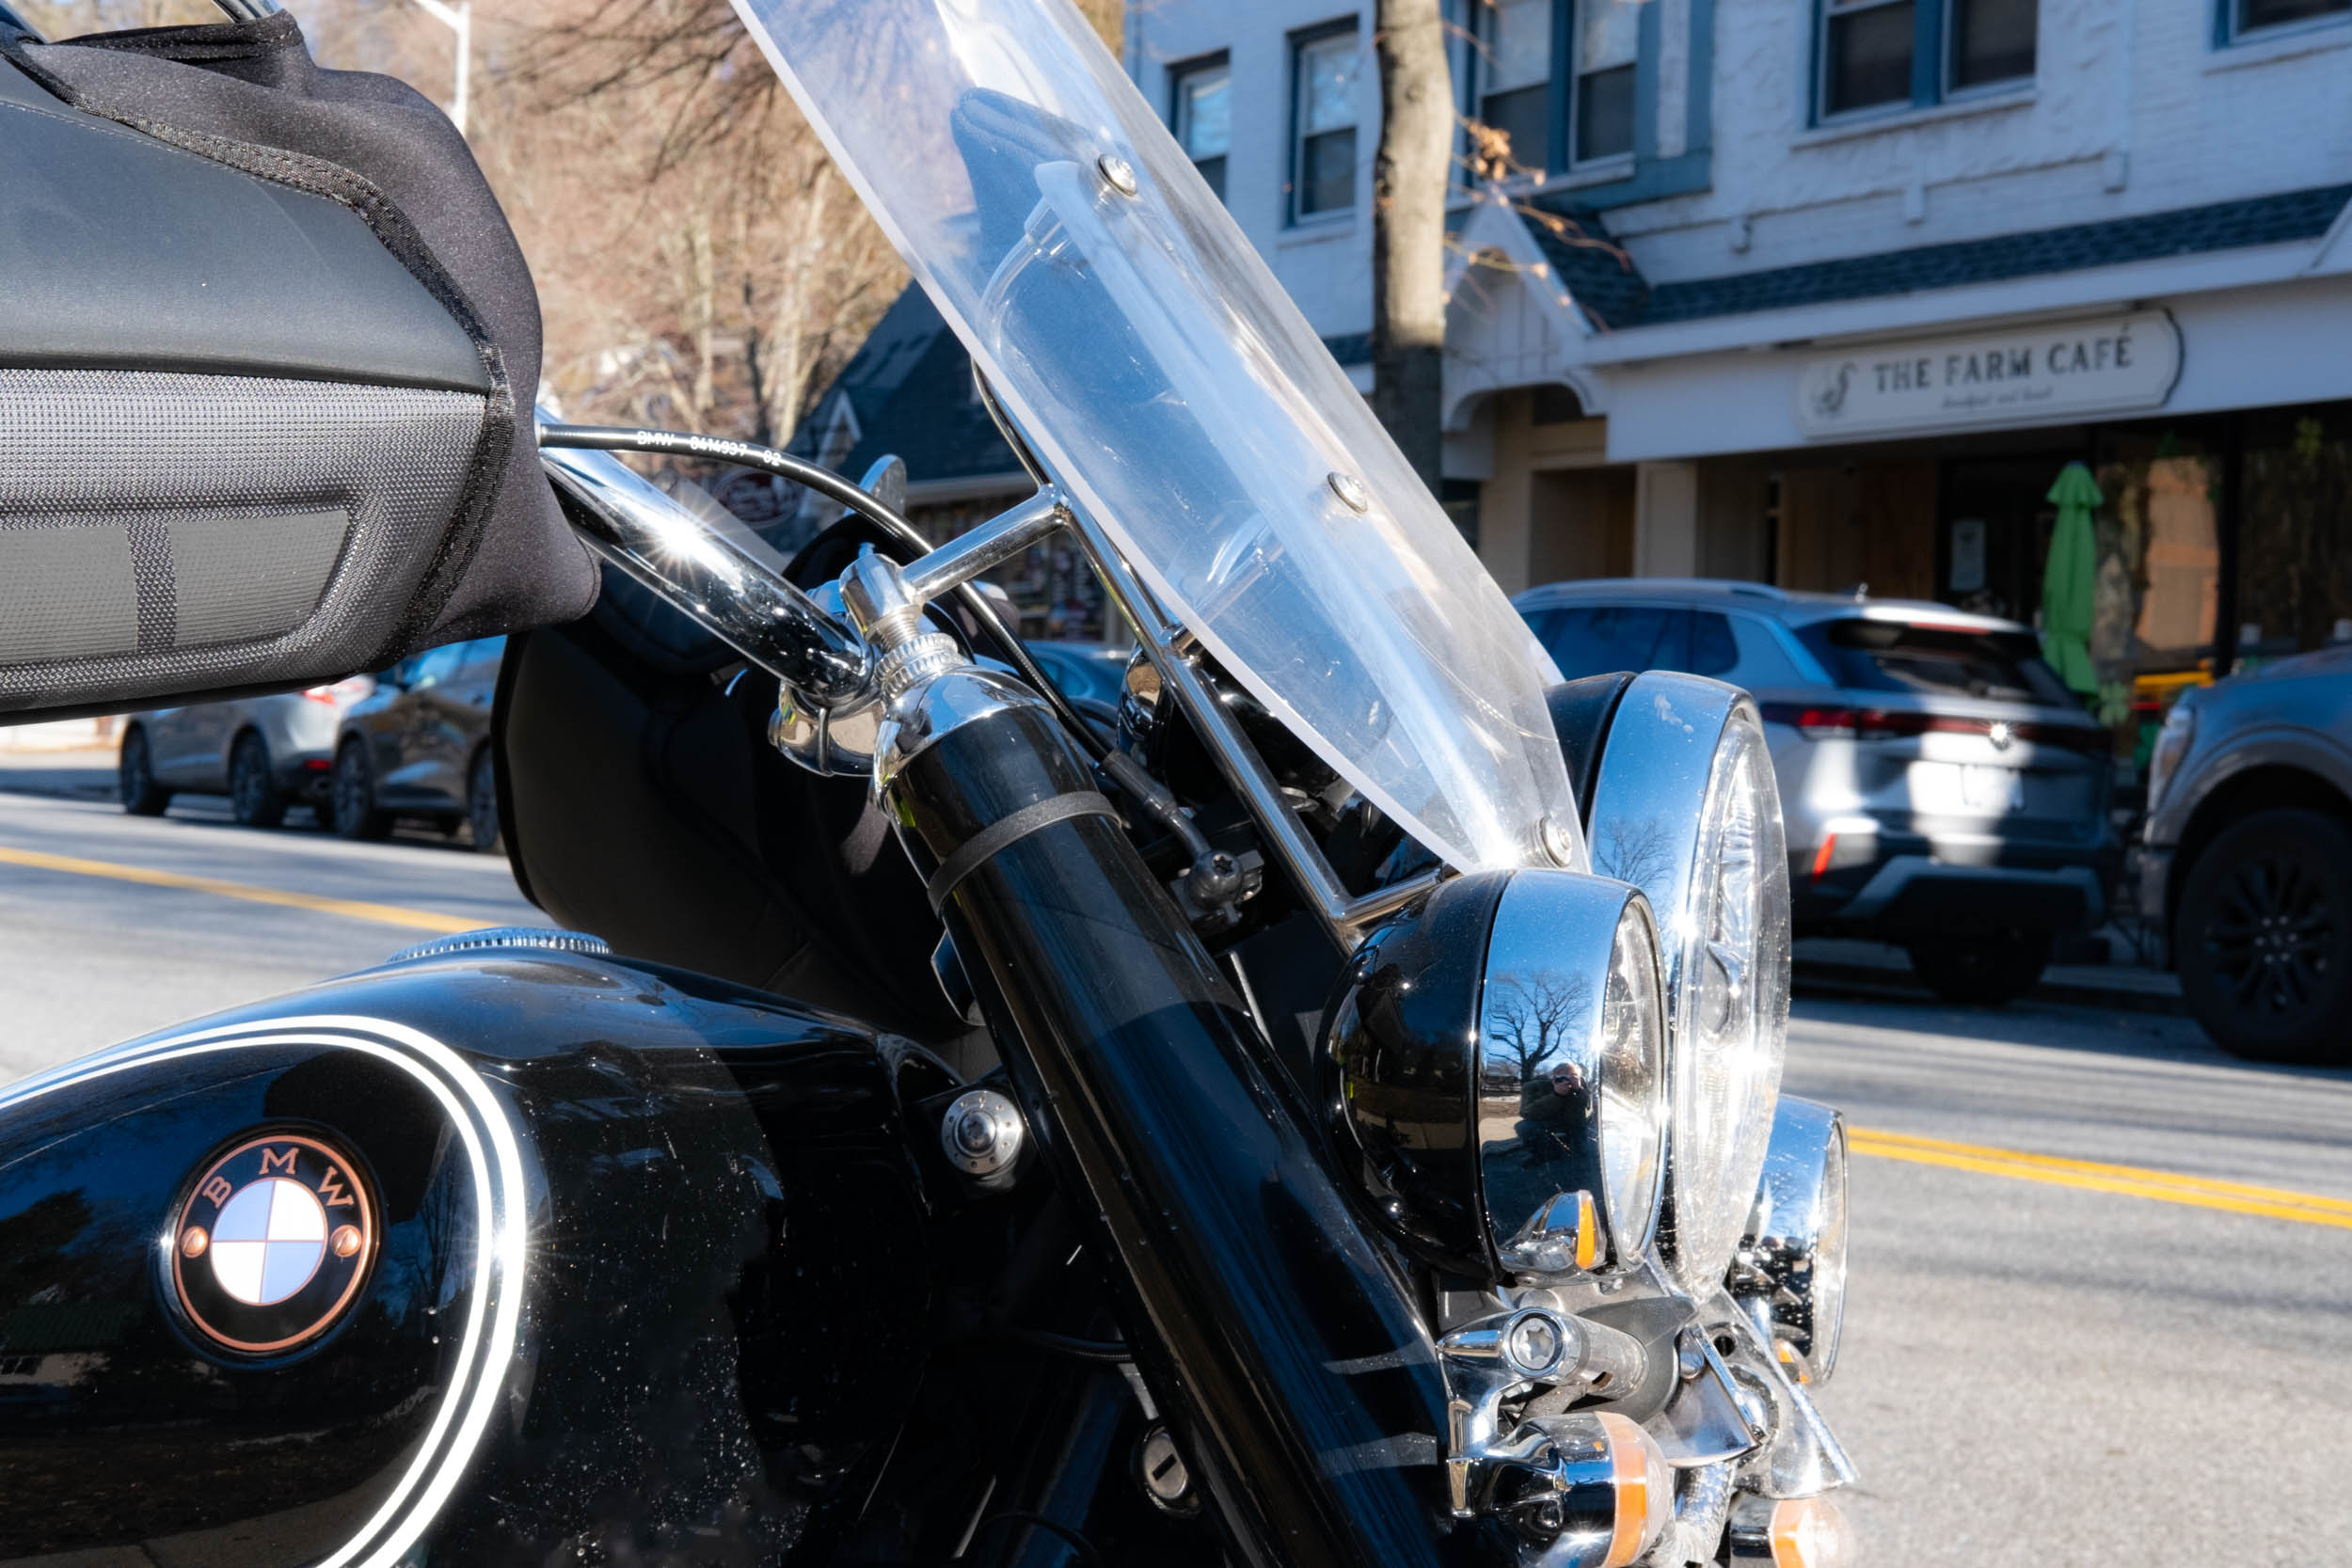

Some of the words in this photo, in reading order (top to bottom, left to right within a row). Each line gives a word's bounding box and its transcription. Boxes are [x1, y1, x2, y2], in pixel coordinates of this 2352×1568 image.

[1873, 358, 1931, 392] THE
[1946, 348, 2032, 386] FARM
[2047, 323, 2133, 374] CAFÉ
[637, 431, 675, 447] BMW
[763, 450, 782, 467] 02
[202, 1147, 354, 1209] BMW
